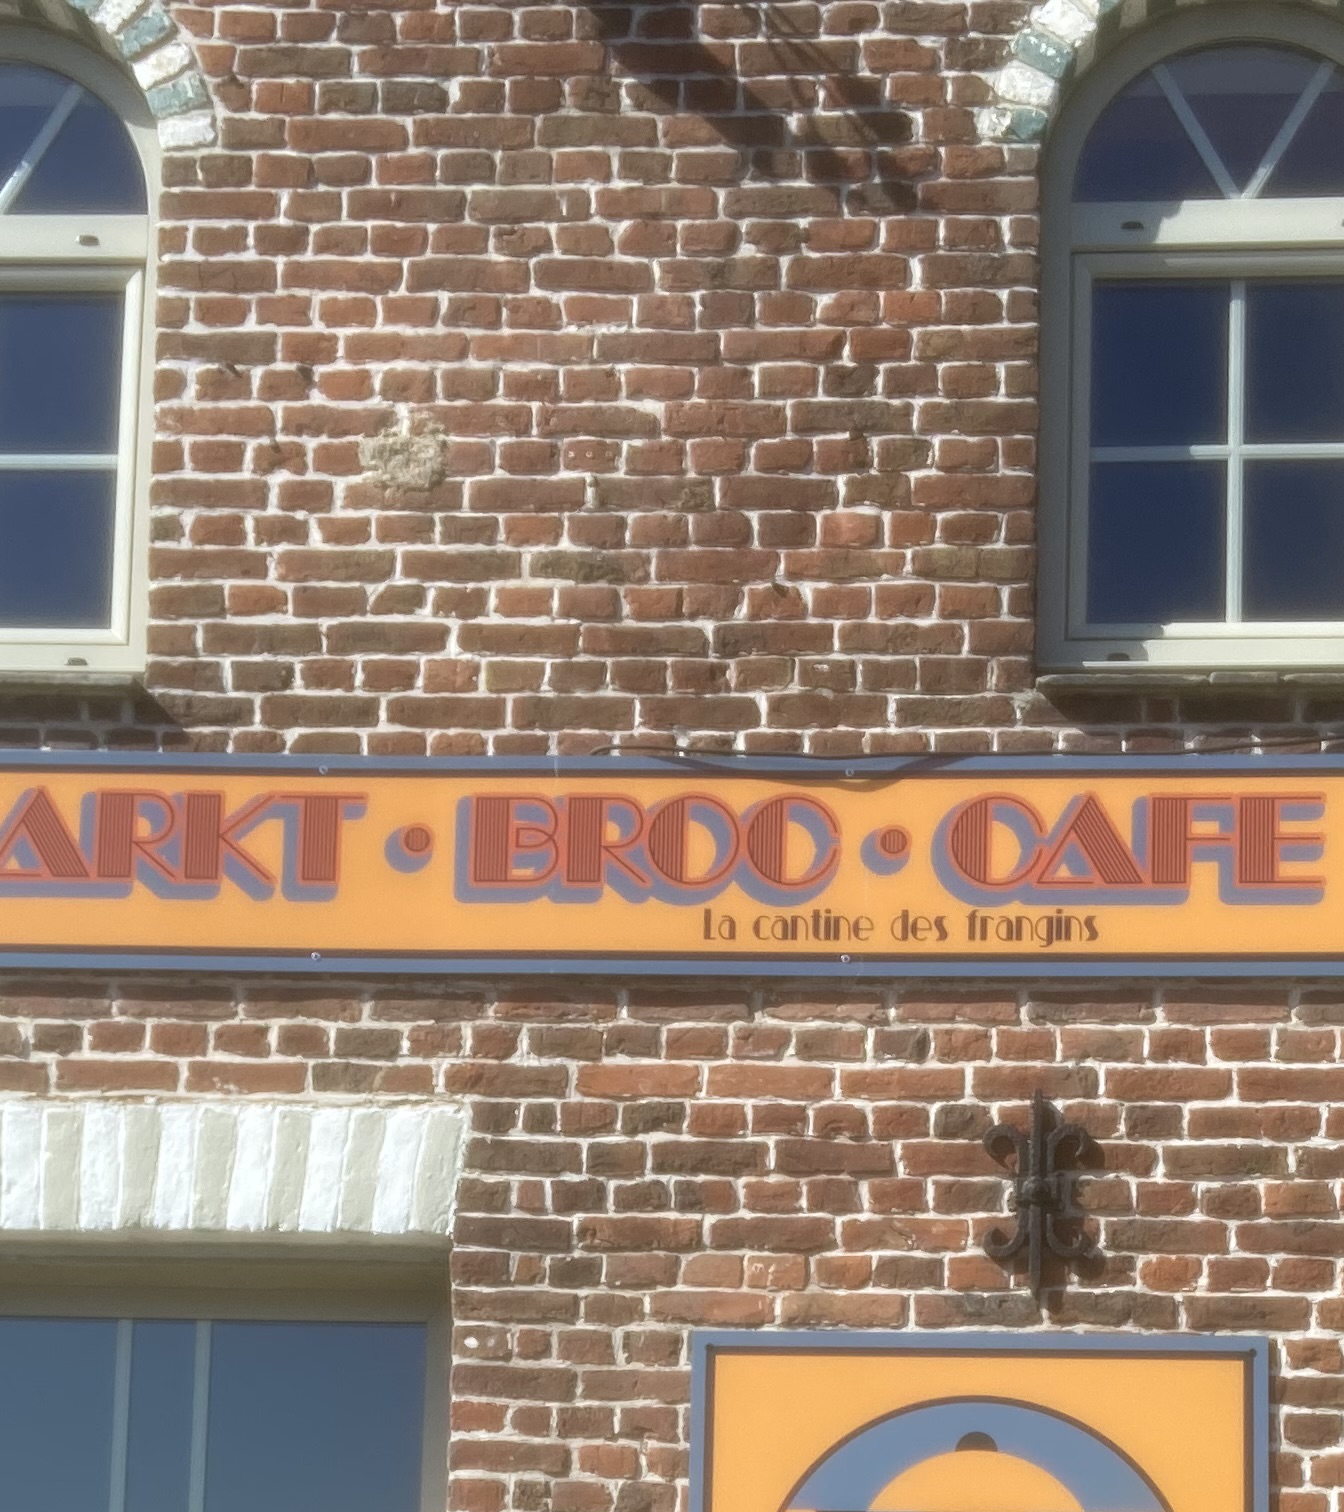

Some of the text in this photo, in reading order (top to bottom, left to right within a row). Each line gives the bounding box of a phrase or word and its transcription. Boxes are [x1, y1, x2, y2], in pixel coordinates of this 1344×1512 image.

[454, 788, 843, 905] BROC
[931, 790, 1327, 907] CAFE
[702, 908, 1100, 949] La cantine des frangins
